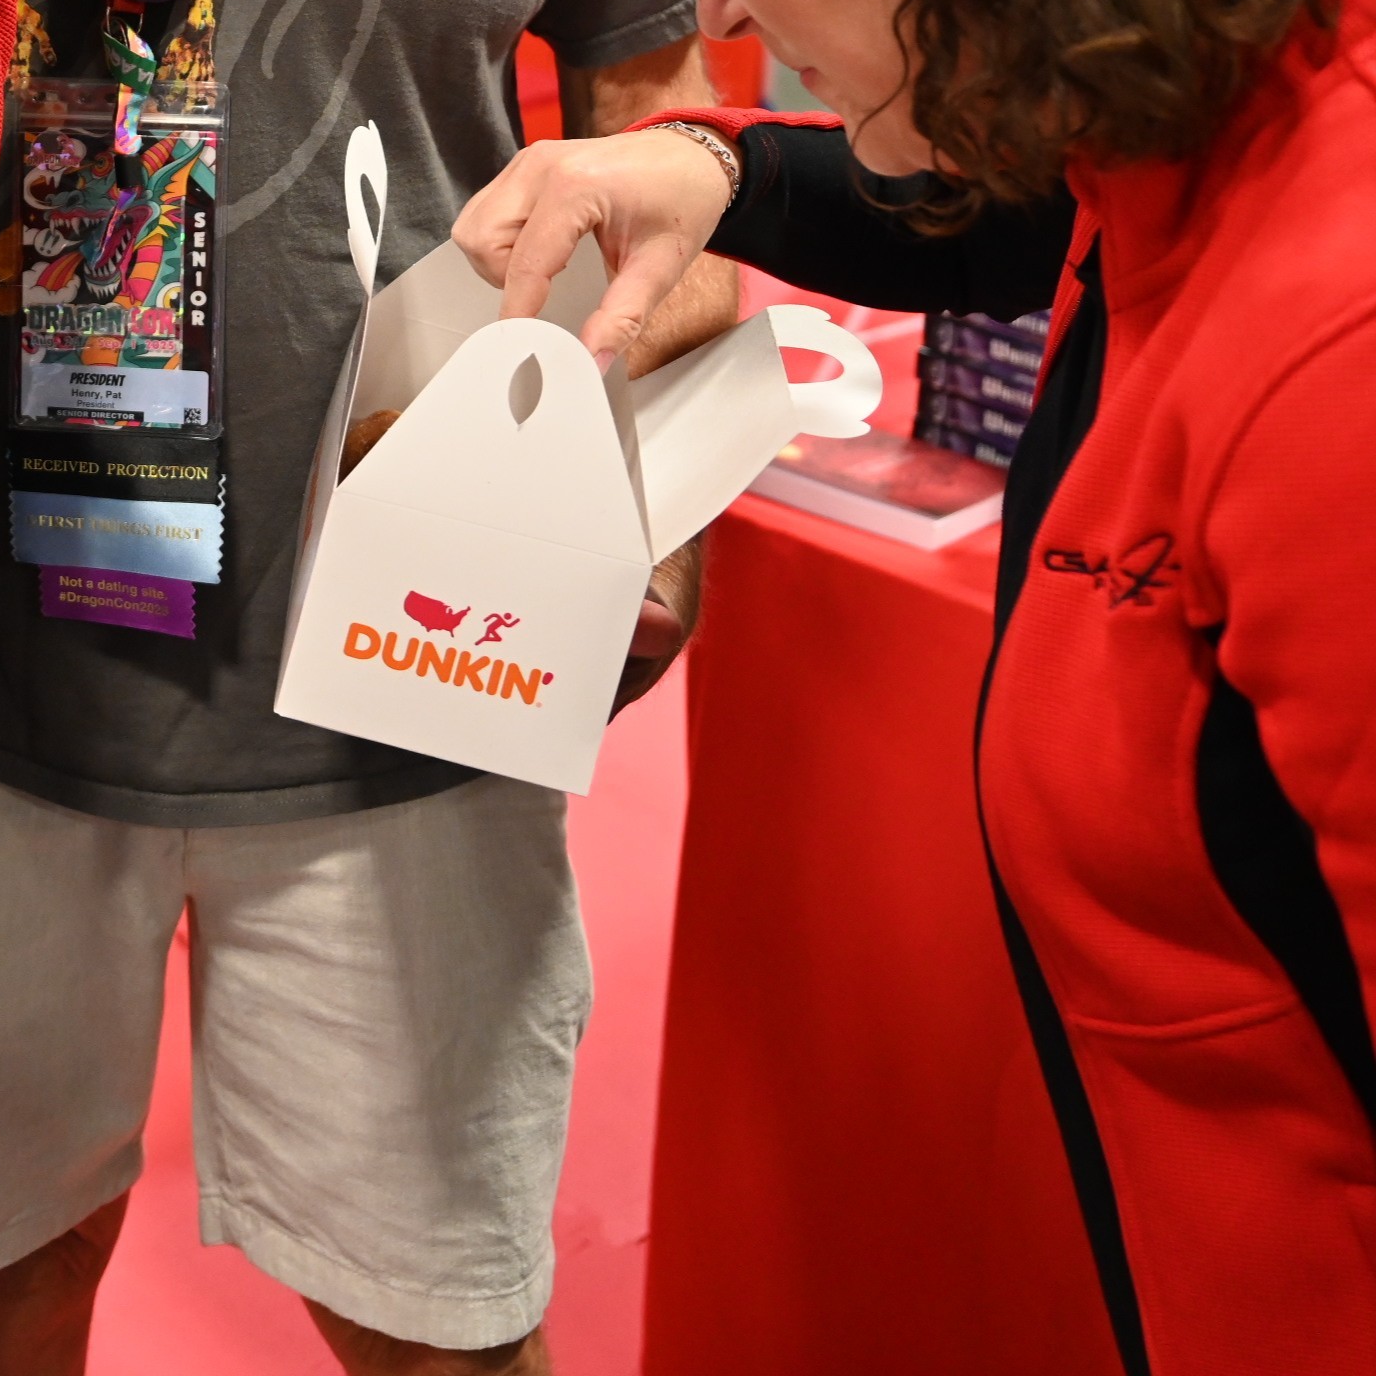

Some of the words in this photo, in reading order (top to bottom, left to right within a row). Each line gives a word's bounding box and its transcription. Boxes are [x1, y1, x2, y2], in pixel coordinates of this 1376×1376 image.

[189, 212, 208, 326] SENIOR
[146, 340, 175, 350] 2025
[70, 373, 126, 386] PRESIDENT
[71, 389, 103, 400] Henry,
[106, 390, 122, 399] Pat
[77, 400, 115, 409] President
[57, 410, 89, 418] SENIOR
[91, 411, 134, 420] DIRECTOR
[24, 457, 100, 474] RECEIVED
[107, 463, 209, 480] PROTECTION
[38, 514, 84, 529] FIRST
[155, 525, 203, 540] FIRST
[60, 576, 83, 588] Not
[86, 580, 94, 588] a
[98, 580, 138, 596] dating
[343, 622, 554, 705] DUNKIN'
